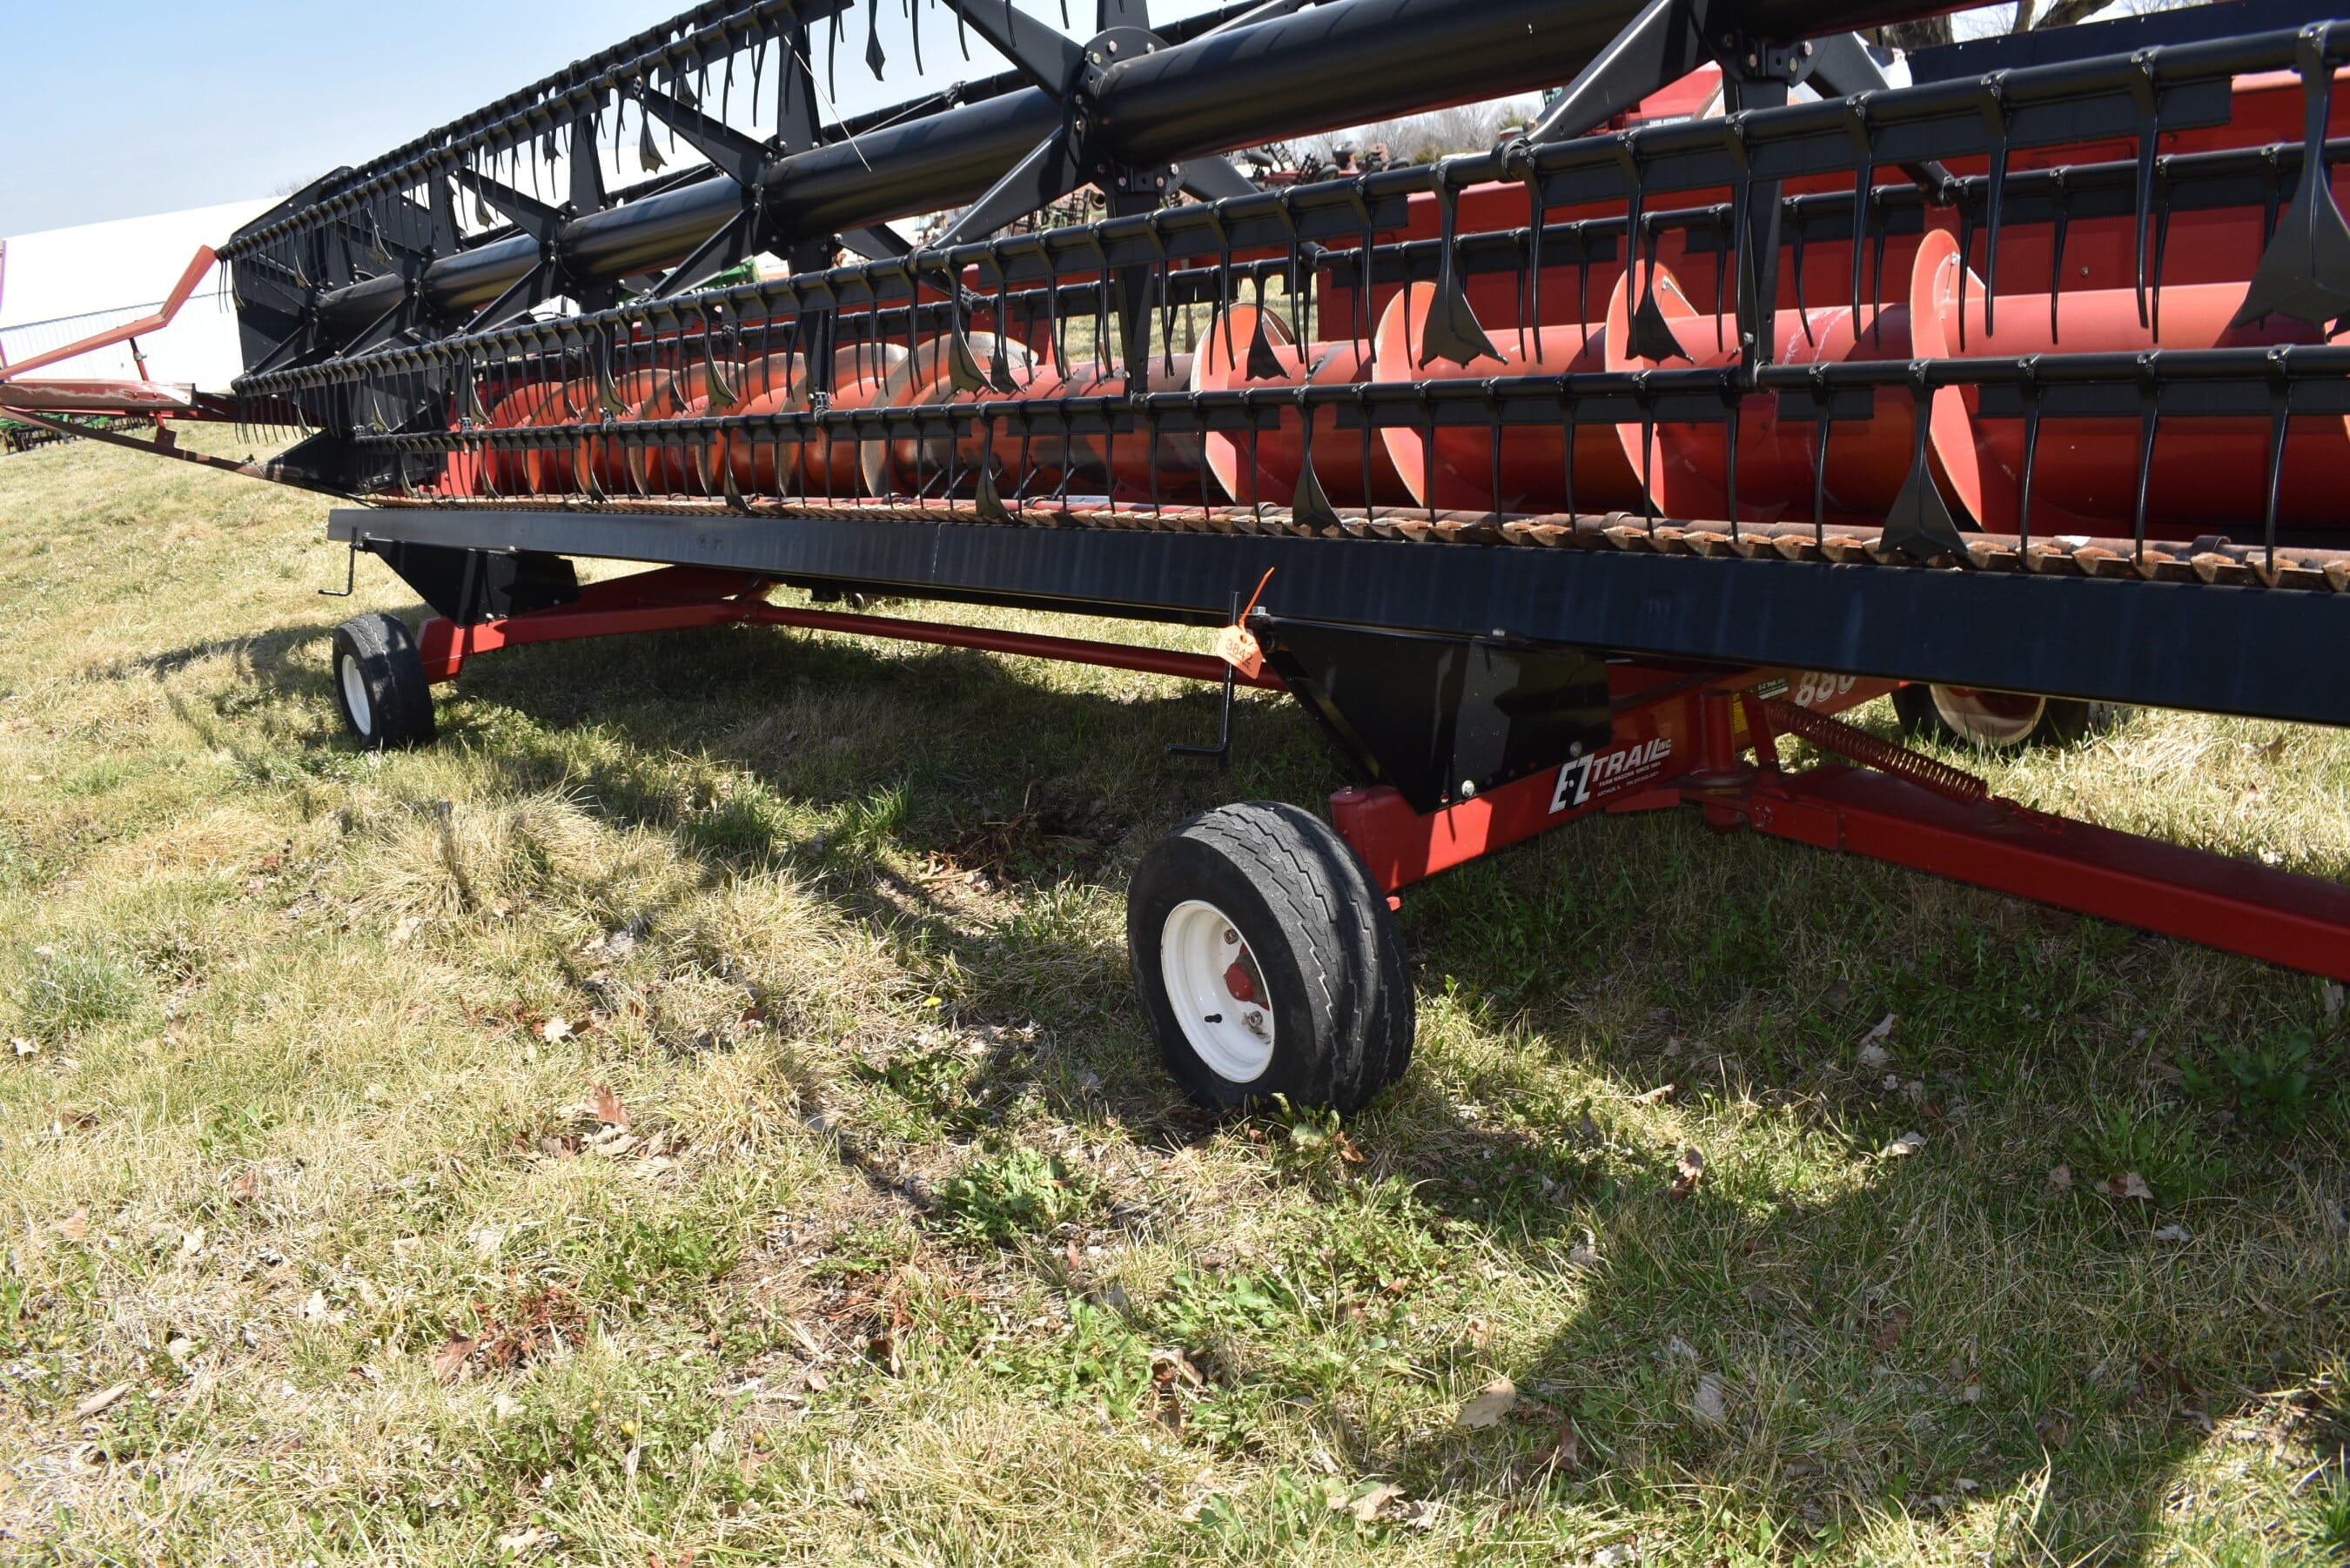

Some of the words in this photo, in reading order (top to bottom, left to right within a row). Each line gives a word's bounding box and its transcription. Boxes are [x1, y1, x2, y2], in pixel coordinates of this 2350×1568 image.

[1225, 639, 1253, 663] 3842
[1592, 738, 1670, 782] TRAIL
[1599, 777, 1614, 787] FARM
